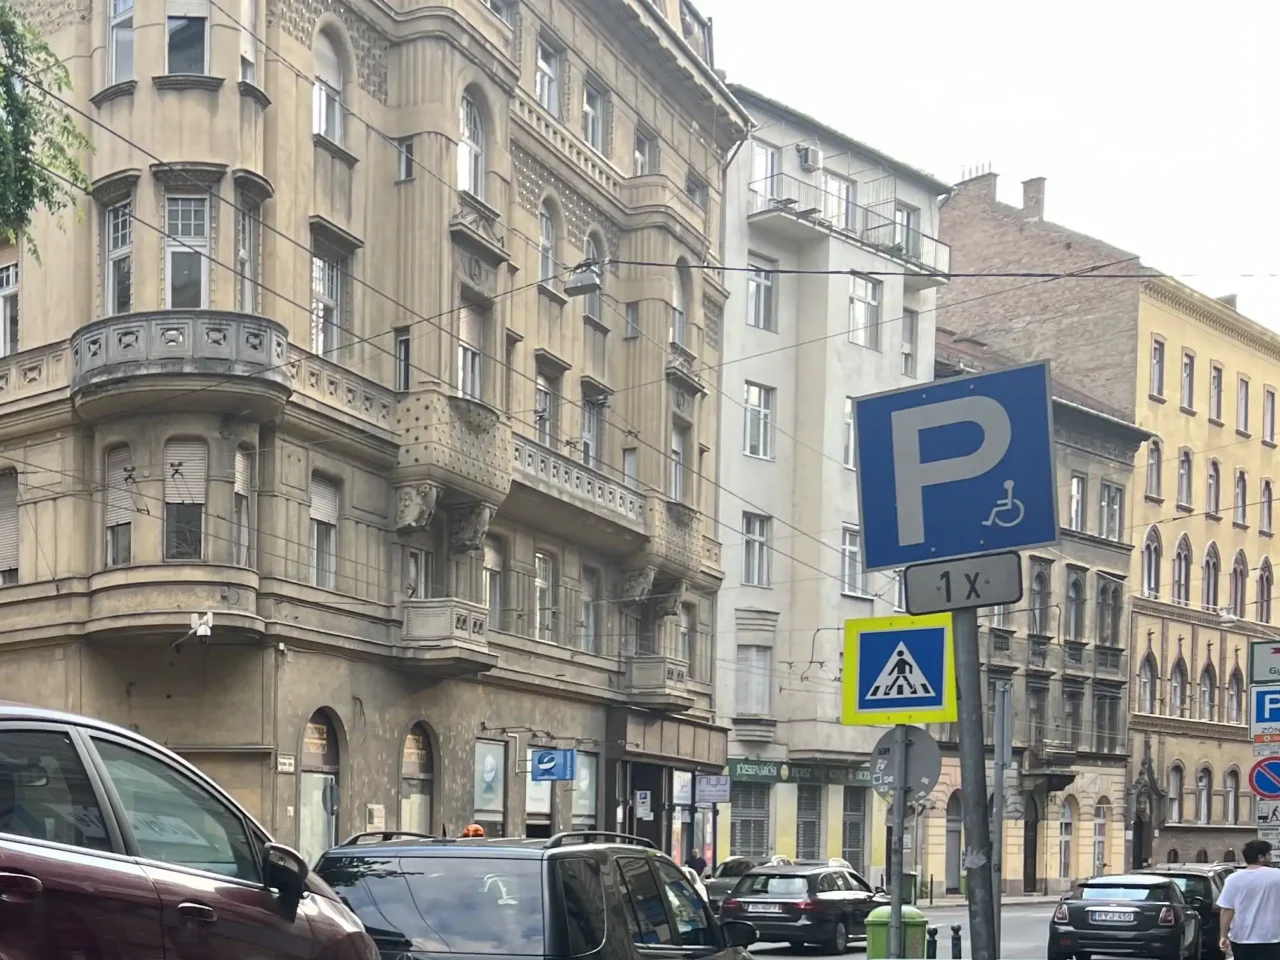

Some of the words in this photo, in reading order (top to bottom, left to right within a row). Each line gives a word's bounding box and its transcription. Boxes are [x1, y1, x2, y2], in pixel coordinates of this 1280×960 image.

[891, 395, 1012, 547] P
[940, 570, 952, 603] 1
[1264, 694, 1280, 719] P
[1261, 725, 1280, 734] ZÓN
